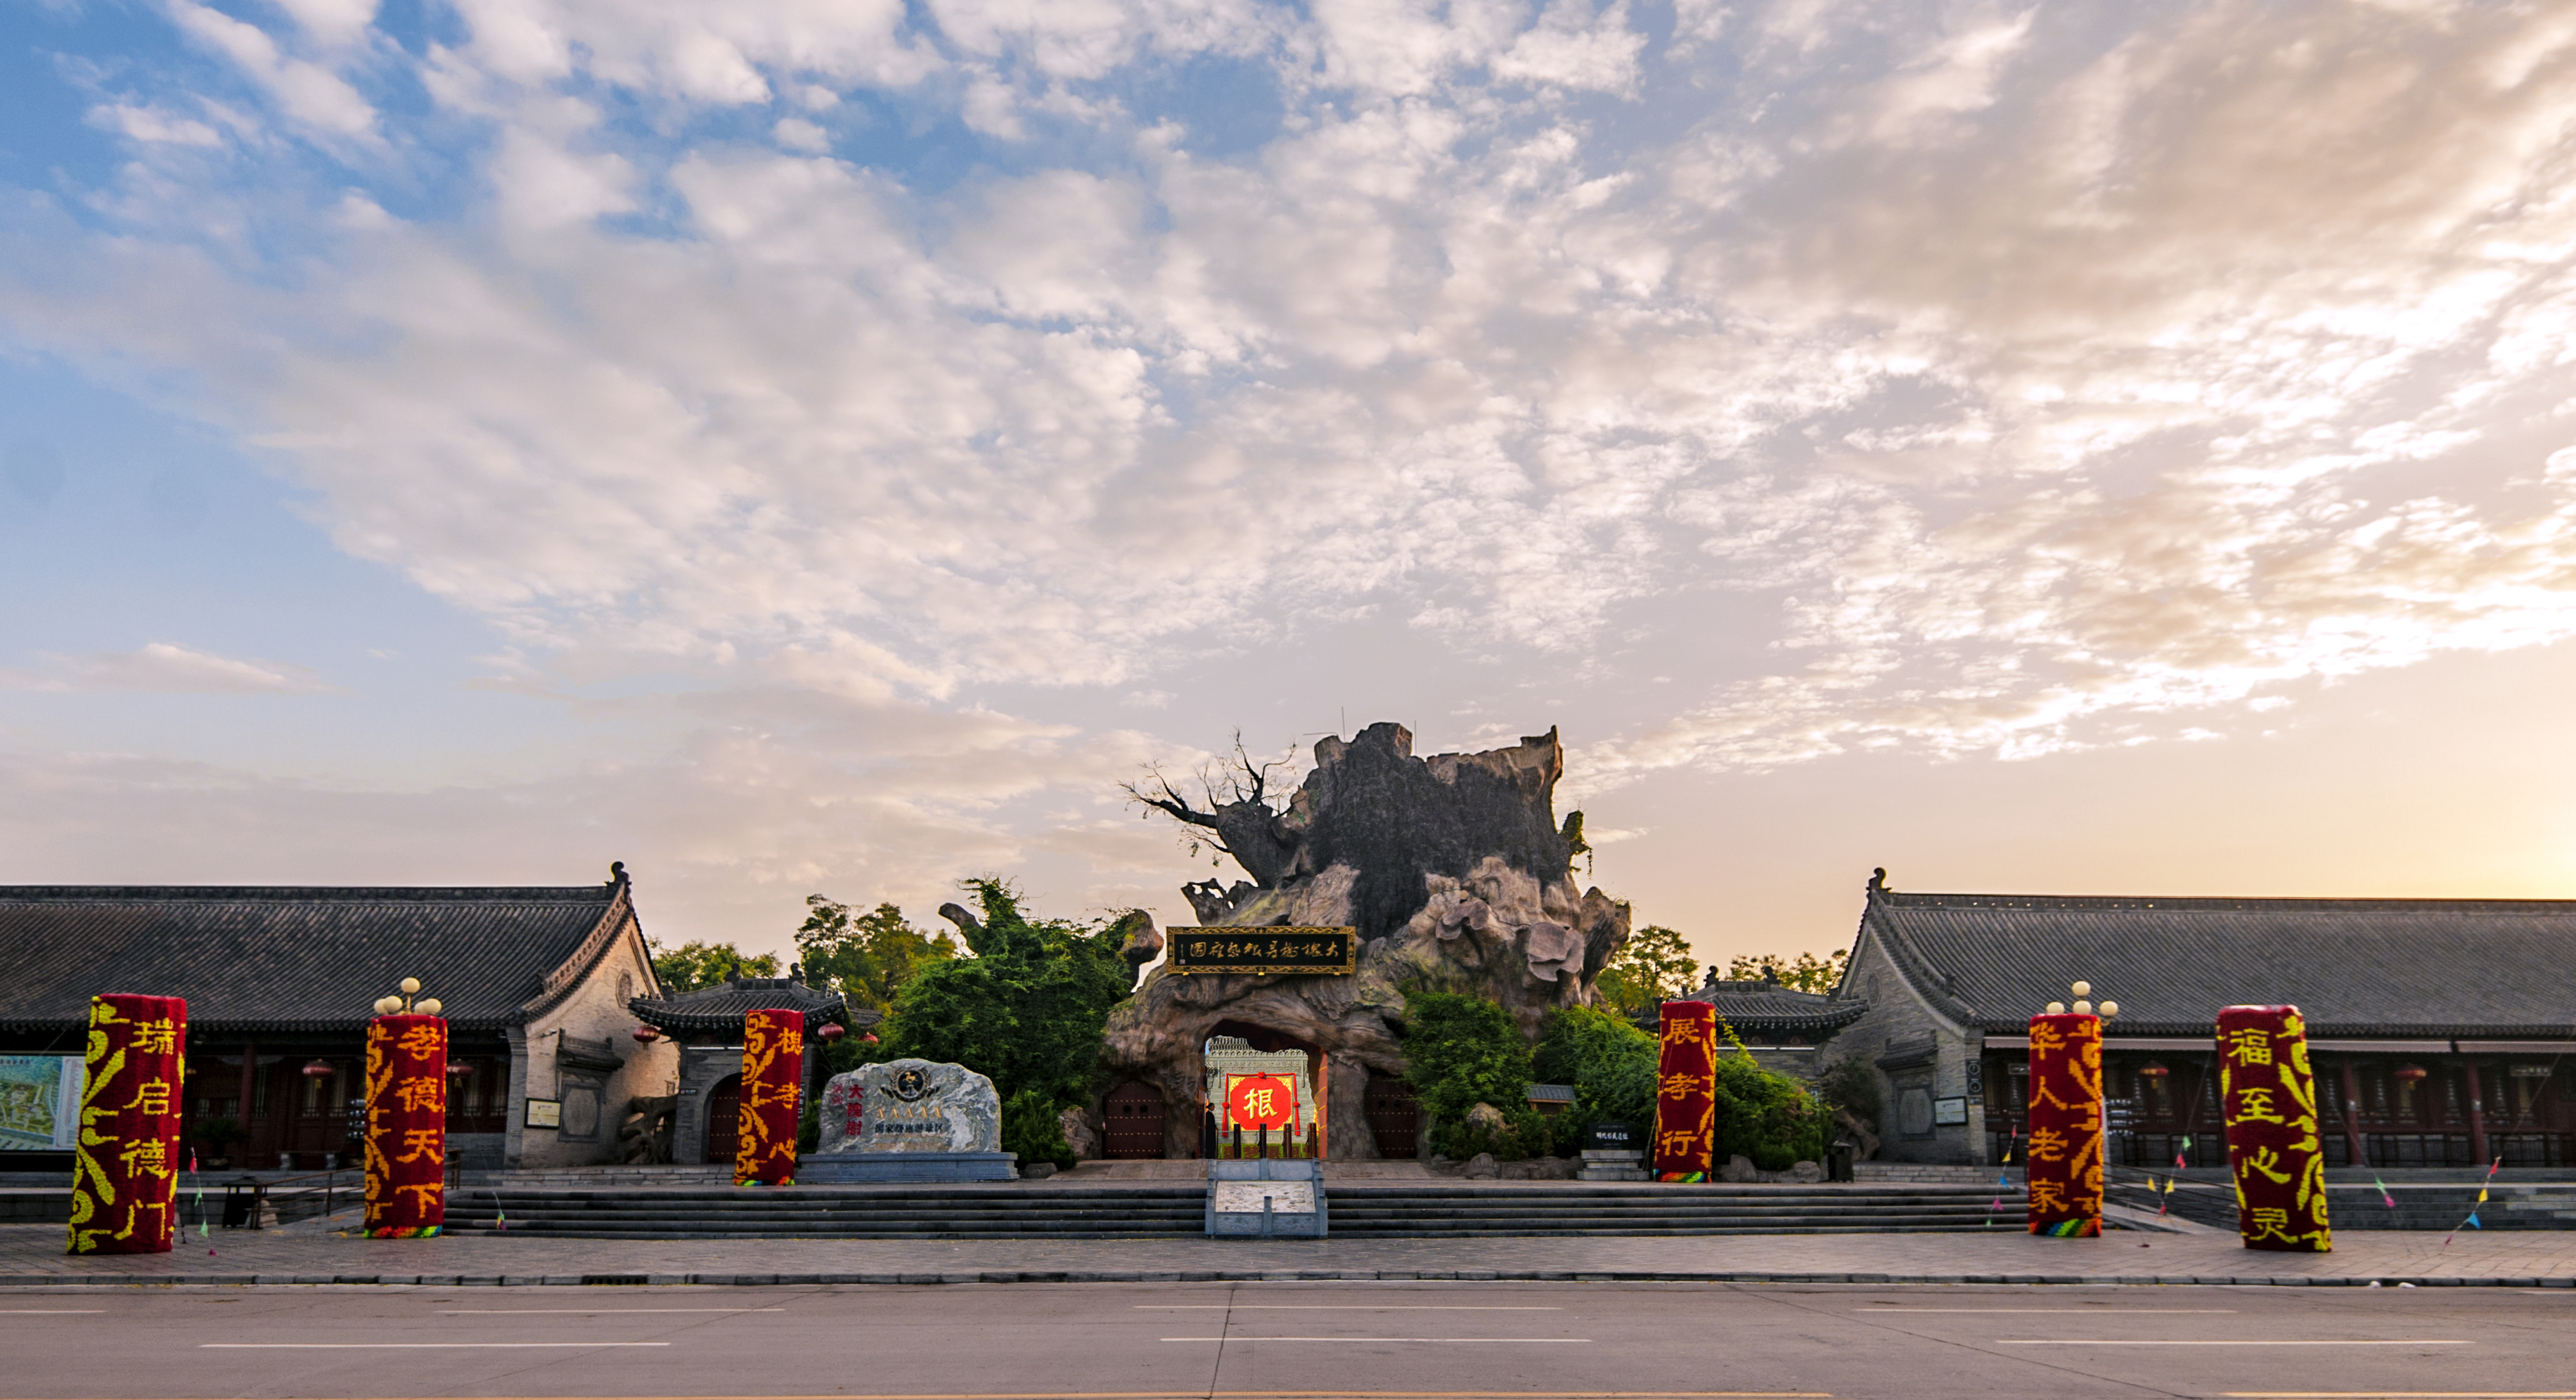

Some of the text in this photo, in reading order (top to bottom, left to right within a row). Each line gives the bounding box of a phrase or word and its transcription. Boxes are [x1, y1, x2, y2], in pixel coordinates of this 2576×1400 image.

[114, 1018, 177, 1240] 瑞启德门
[396, 1024, 444, 1219] 孝德天下
[1243, 1088, 1278, 1120] 根
[1662, 1018, 1700, 1157] 展孝行
[2029, 1021, 2069, 1214] 华人老家
[2228, 1027, 2298, 1244] 福至心灵
